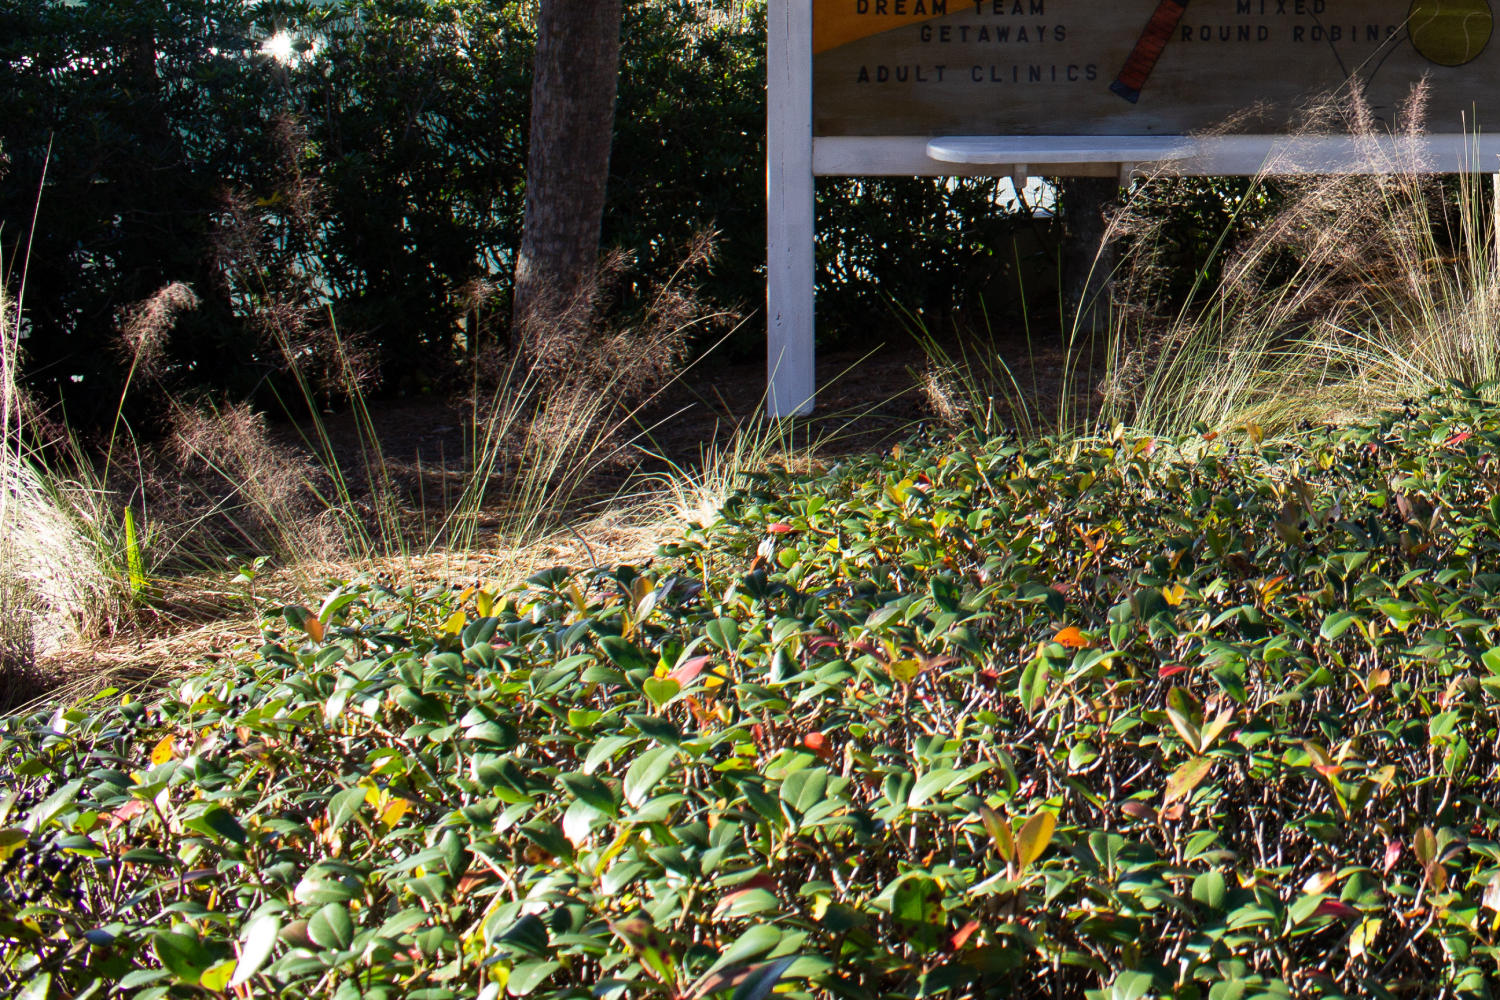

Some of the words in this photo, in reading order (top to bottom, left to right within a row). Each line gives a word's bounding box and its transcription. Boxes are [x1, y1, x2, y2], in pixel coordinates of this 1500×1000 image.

[920, 24, 1068, 43] GETAWAYS
[1181, 24, 1271, 42] ROUND
[856, 64, 947, 82] ADULT
[971, 62, 1099, 82] CLINICS
